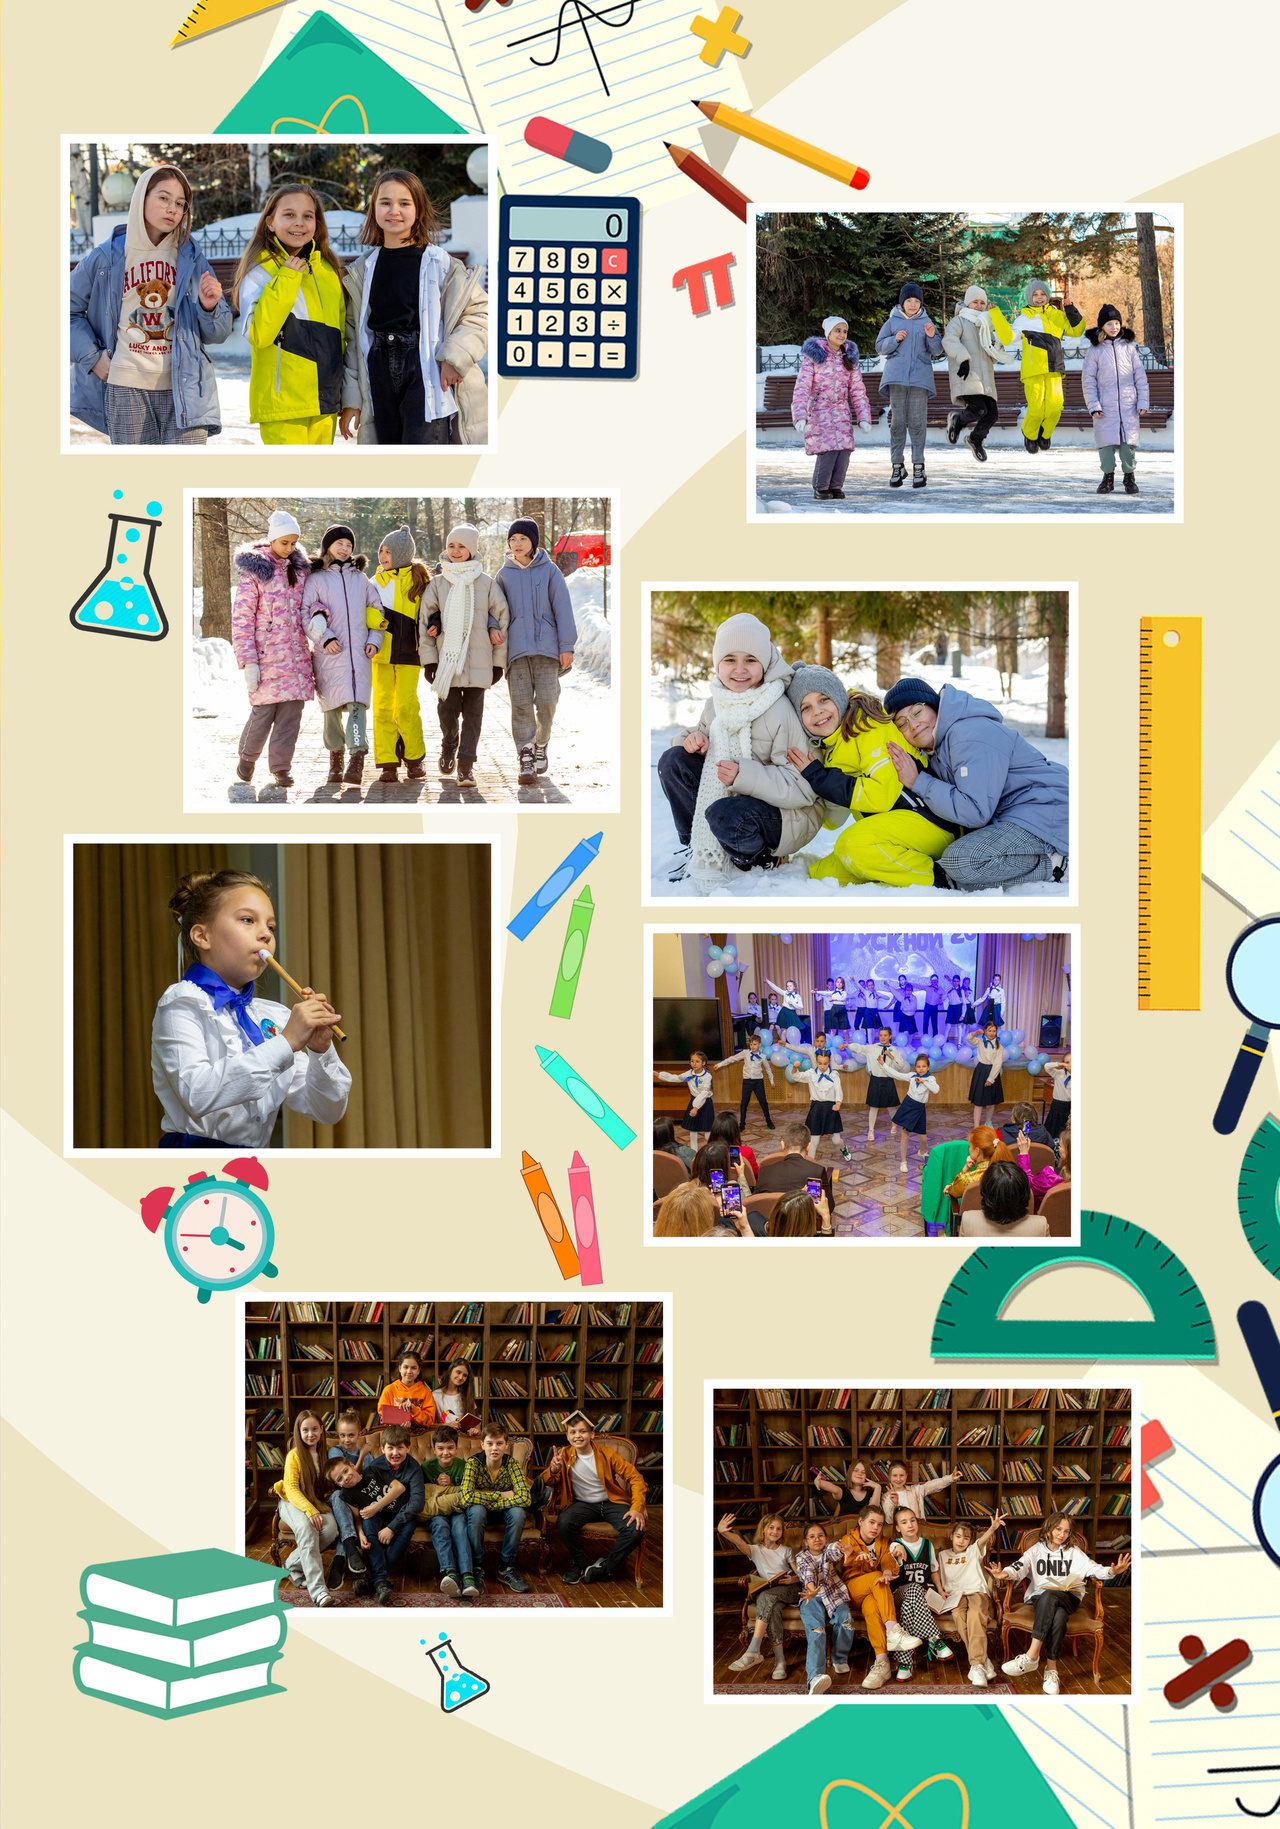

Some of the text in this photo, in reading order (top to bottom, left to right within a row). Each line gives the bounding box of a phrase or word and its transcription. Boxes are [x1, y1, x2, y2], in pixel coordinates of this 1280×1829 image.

[605, 213, 623, 238] 0
[515, 251, 618, 269] 7 8 9 C
[514, 282, 526, 298] 4
[546, 282, 559, 299] 5
[576, 282, 589, 299] 6
[142, 312, 162, 326] W
[515, 314, 523, 331] 1
[545, 315, 557, 332] 2
[576, 315, 589, 332] 3
[128, 342, 150, 351] LUCKY
[513, 346, 525, 363] 0
[352, 723, 361, 746] color
[368, 1485, 381, 1498] FOR
[1036, 1559, 1072, 1576] ONLY
[905, 1569, 925, 1584] 76
